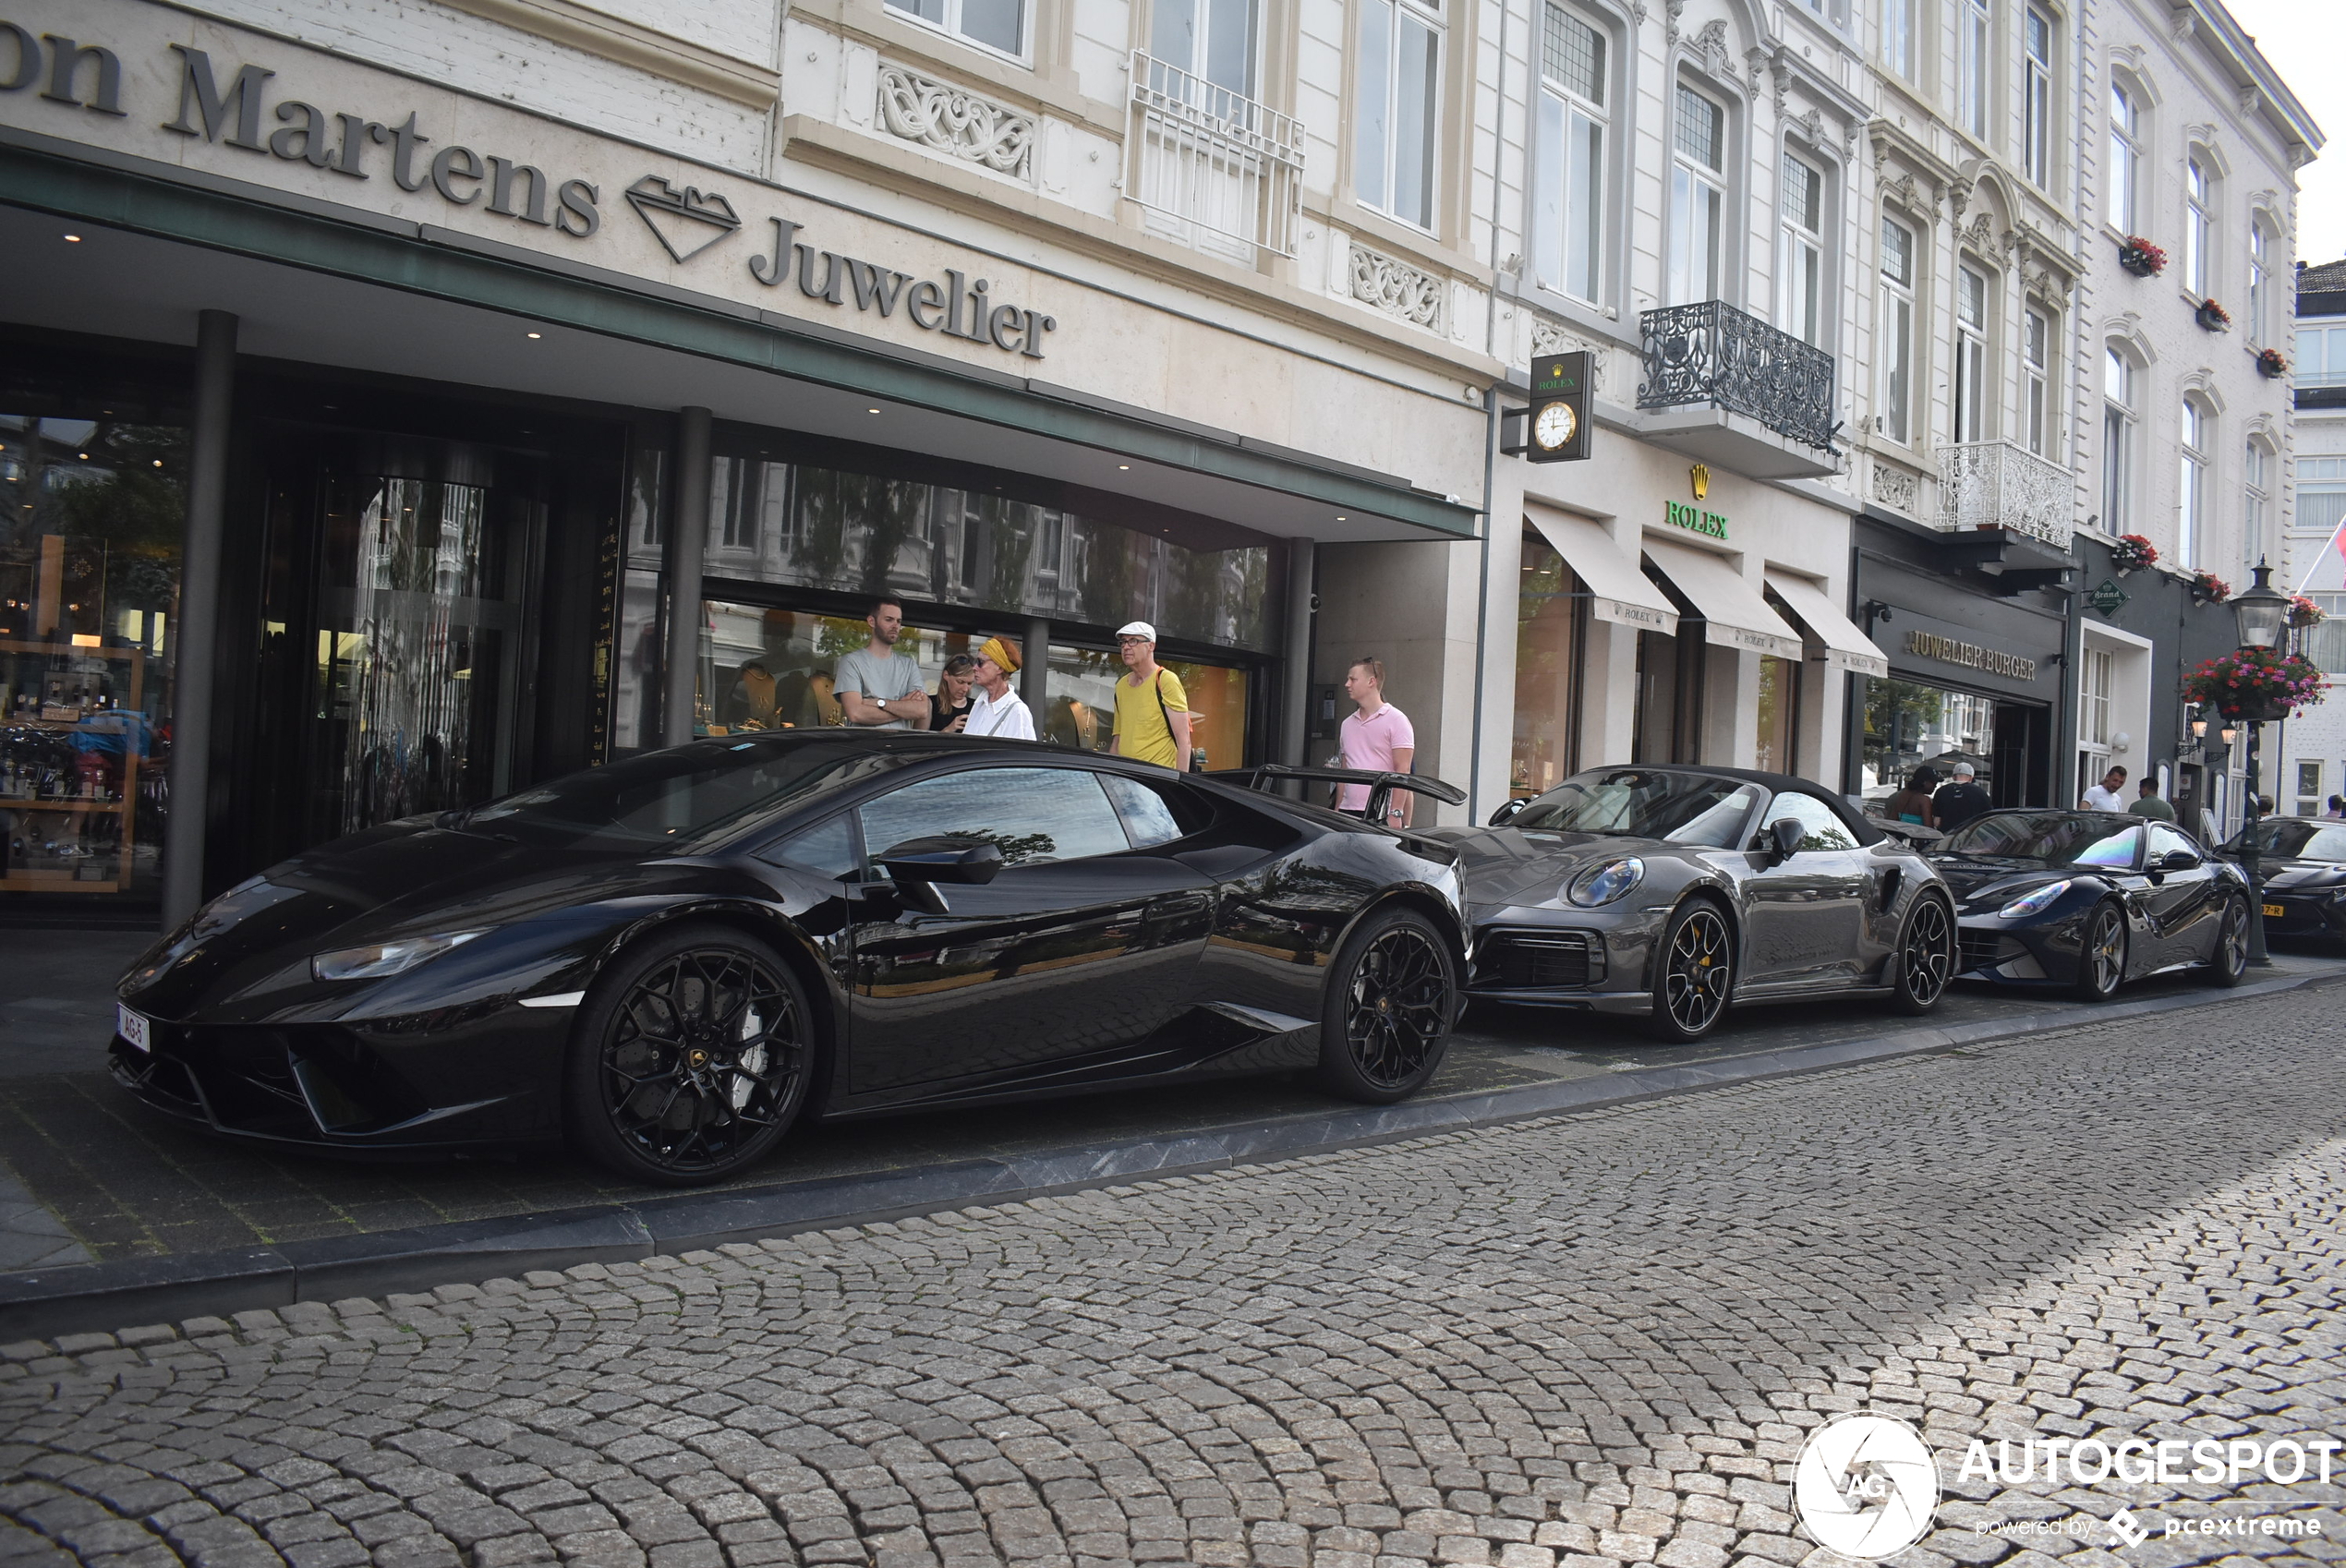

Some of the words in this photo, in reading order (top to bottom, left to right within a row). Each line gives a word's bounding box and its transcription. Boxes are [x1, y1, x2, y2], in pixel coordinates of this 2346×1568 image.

[163, 42, 600, 238] Martens
[749, 216, 1057, 359] Juwelier
[1539, 378, 1575, 390] ROLEX
[1665, 500, 1729, 539] ROLEX
[2095, 590, 2120, 599] Brand
[1625, 609, 1651, 622] ROLEX
[1744, 633, 1766, 648] ROLEX
[1850, 656, 1869, 669] ROLEX
[1909, 630, 1982, 669] JUWELIER
[1985, 648, 2036, 681] BURGER
